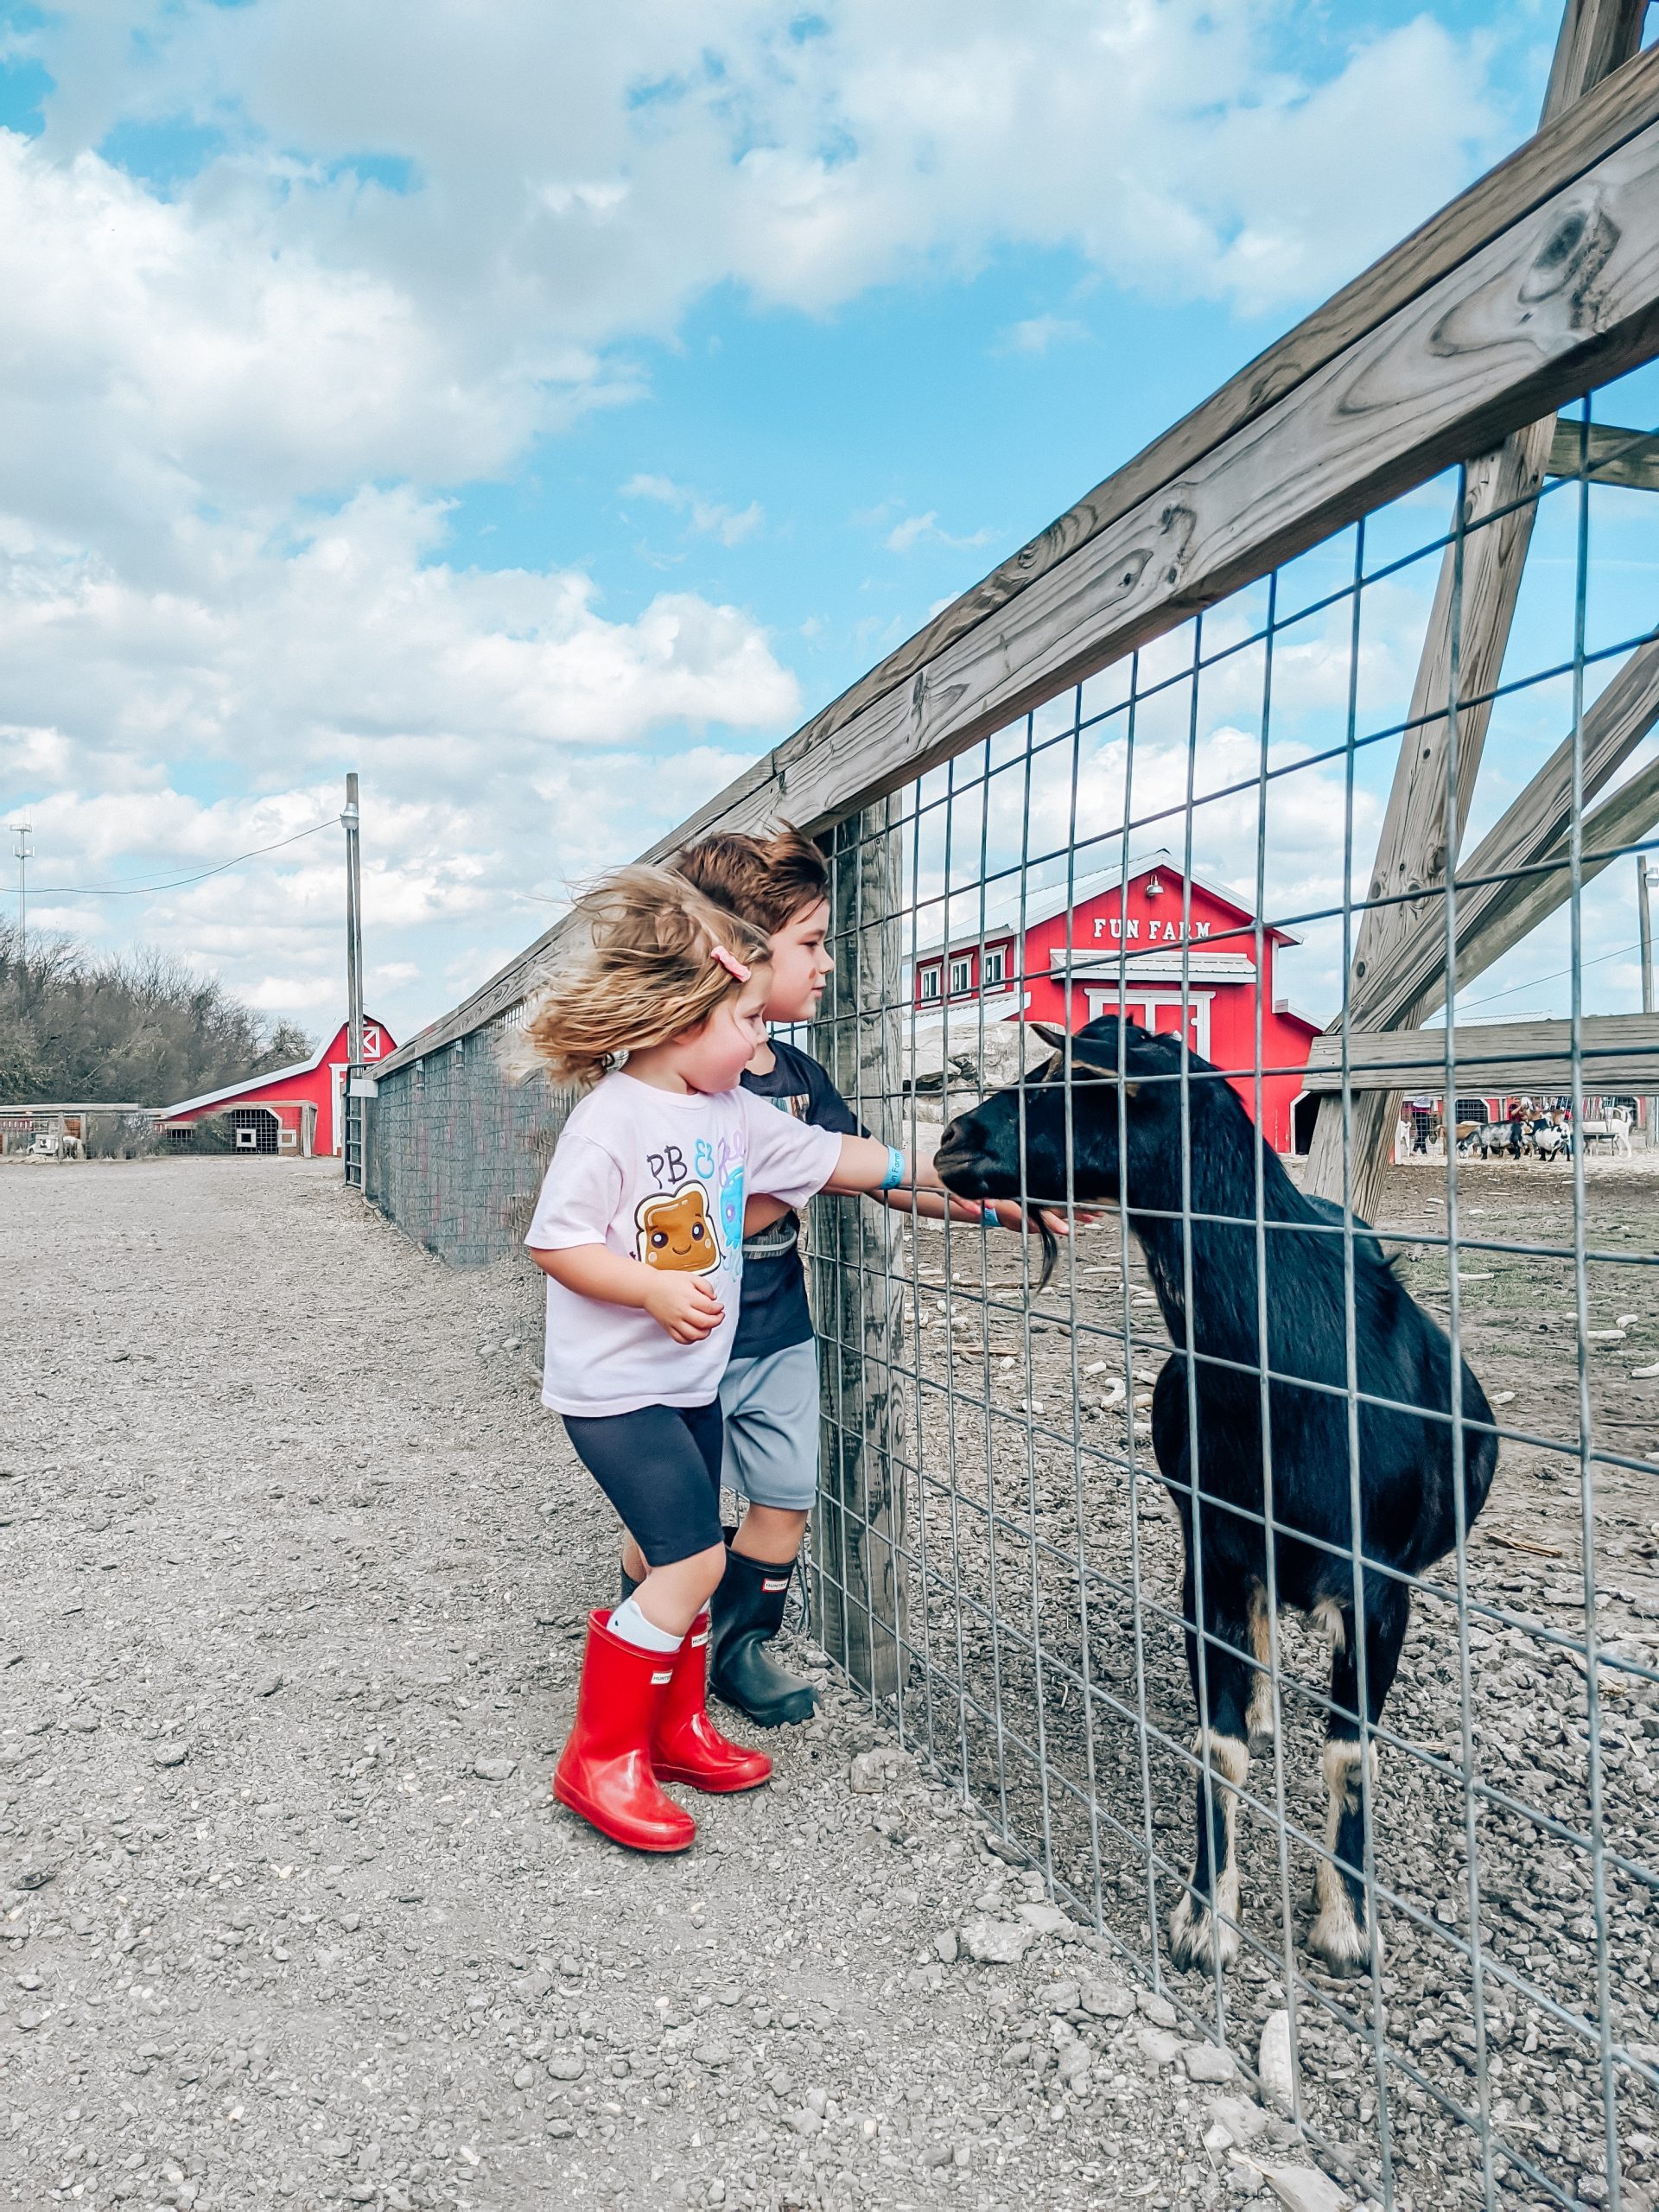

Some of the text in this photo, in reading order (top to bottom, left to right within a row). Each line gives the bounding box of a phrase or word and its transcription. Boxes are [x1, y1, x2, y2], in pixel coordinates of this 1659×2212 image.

[1093, 918, 1211, 941] FUN FARM
[646, 1130, 746, 1190] PB & Jel
[891, 1153, 900, 1173] Farm
